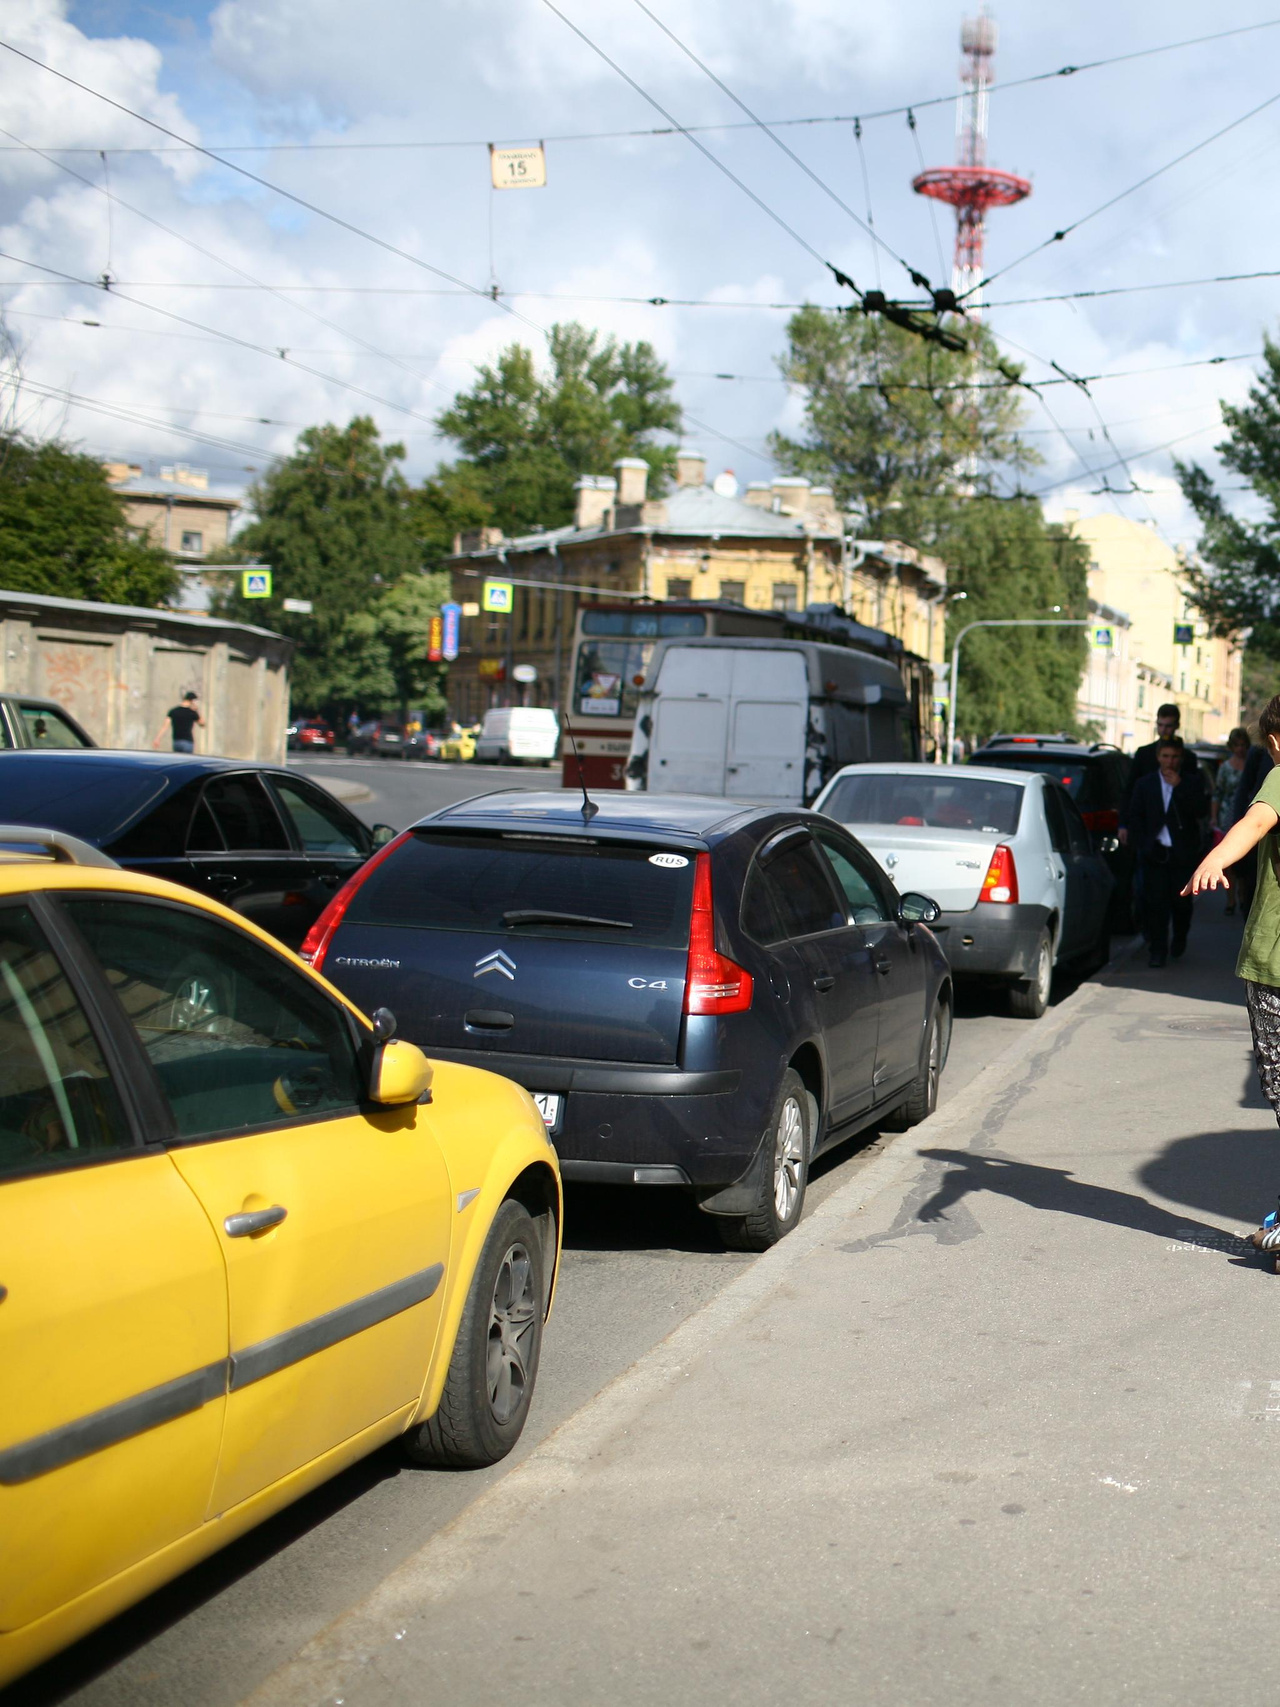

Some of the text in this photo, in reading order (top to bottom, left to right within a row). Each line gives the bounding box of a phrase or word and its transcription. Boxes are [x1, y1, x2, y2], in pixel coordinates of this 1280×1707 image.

[508, 160, 527, 177] 15
[655, 856, 684, 866] RUS
[335, 956, 401, 968] CITROËN
[627, 977, 668, 992] C4
